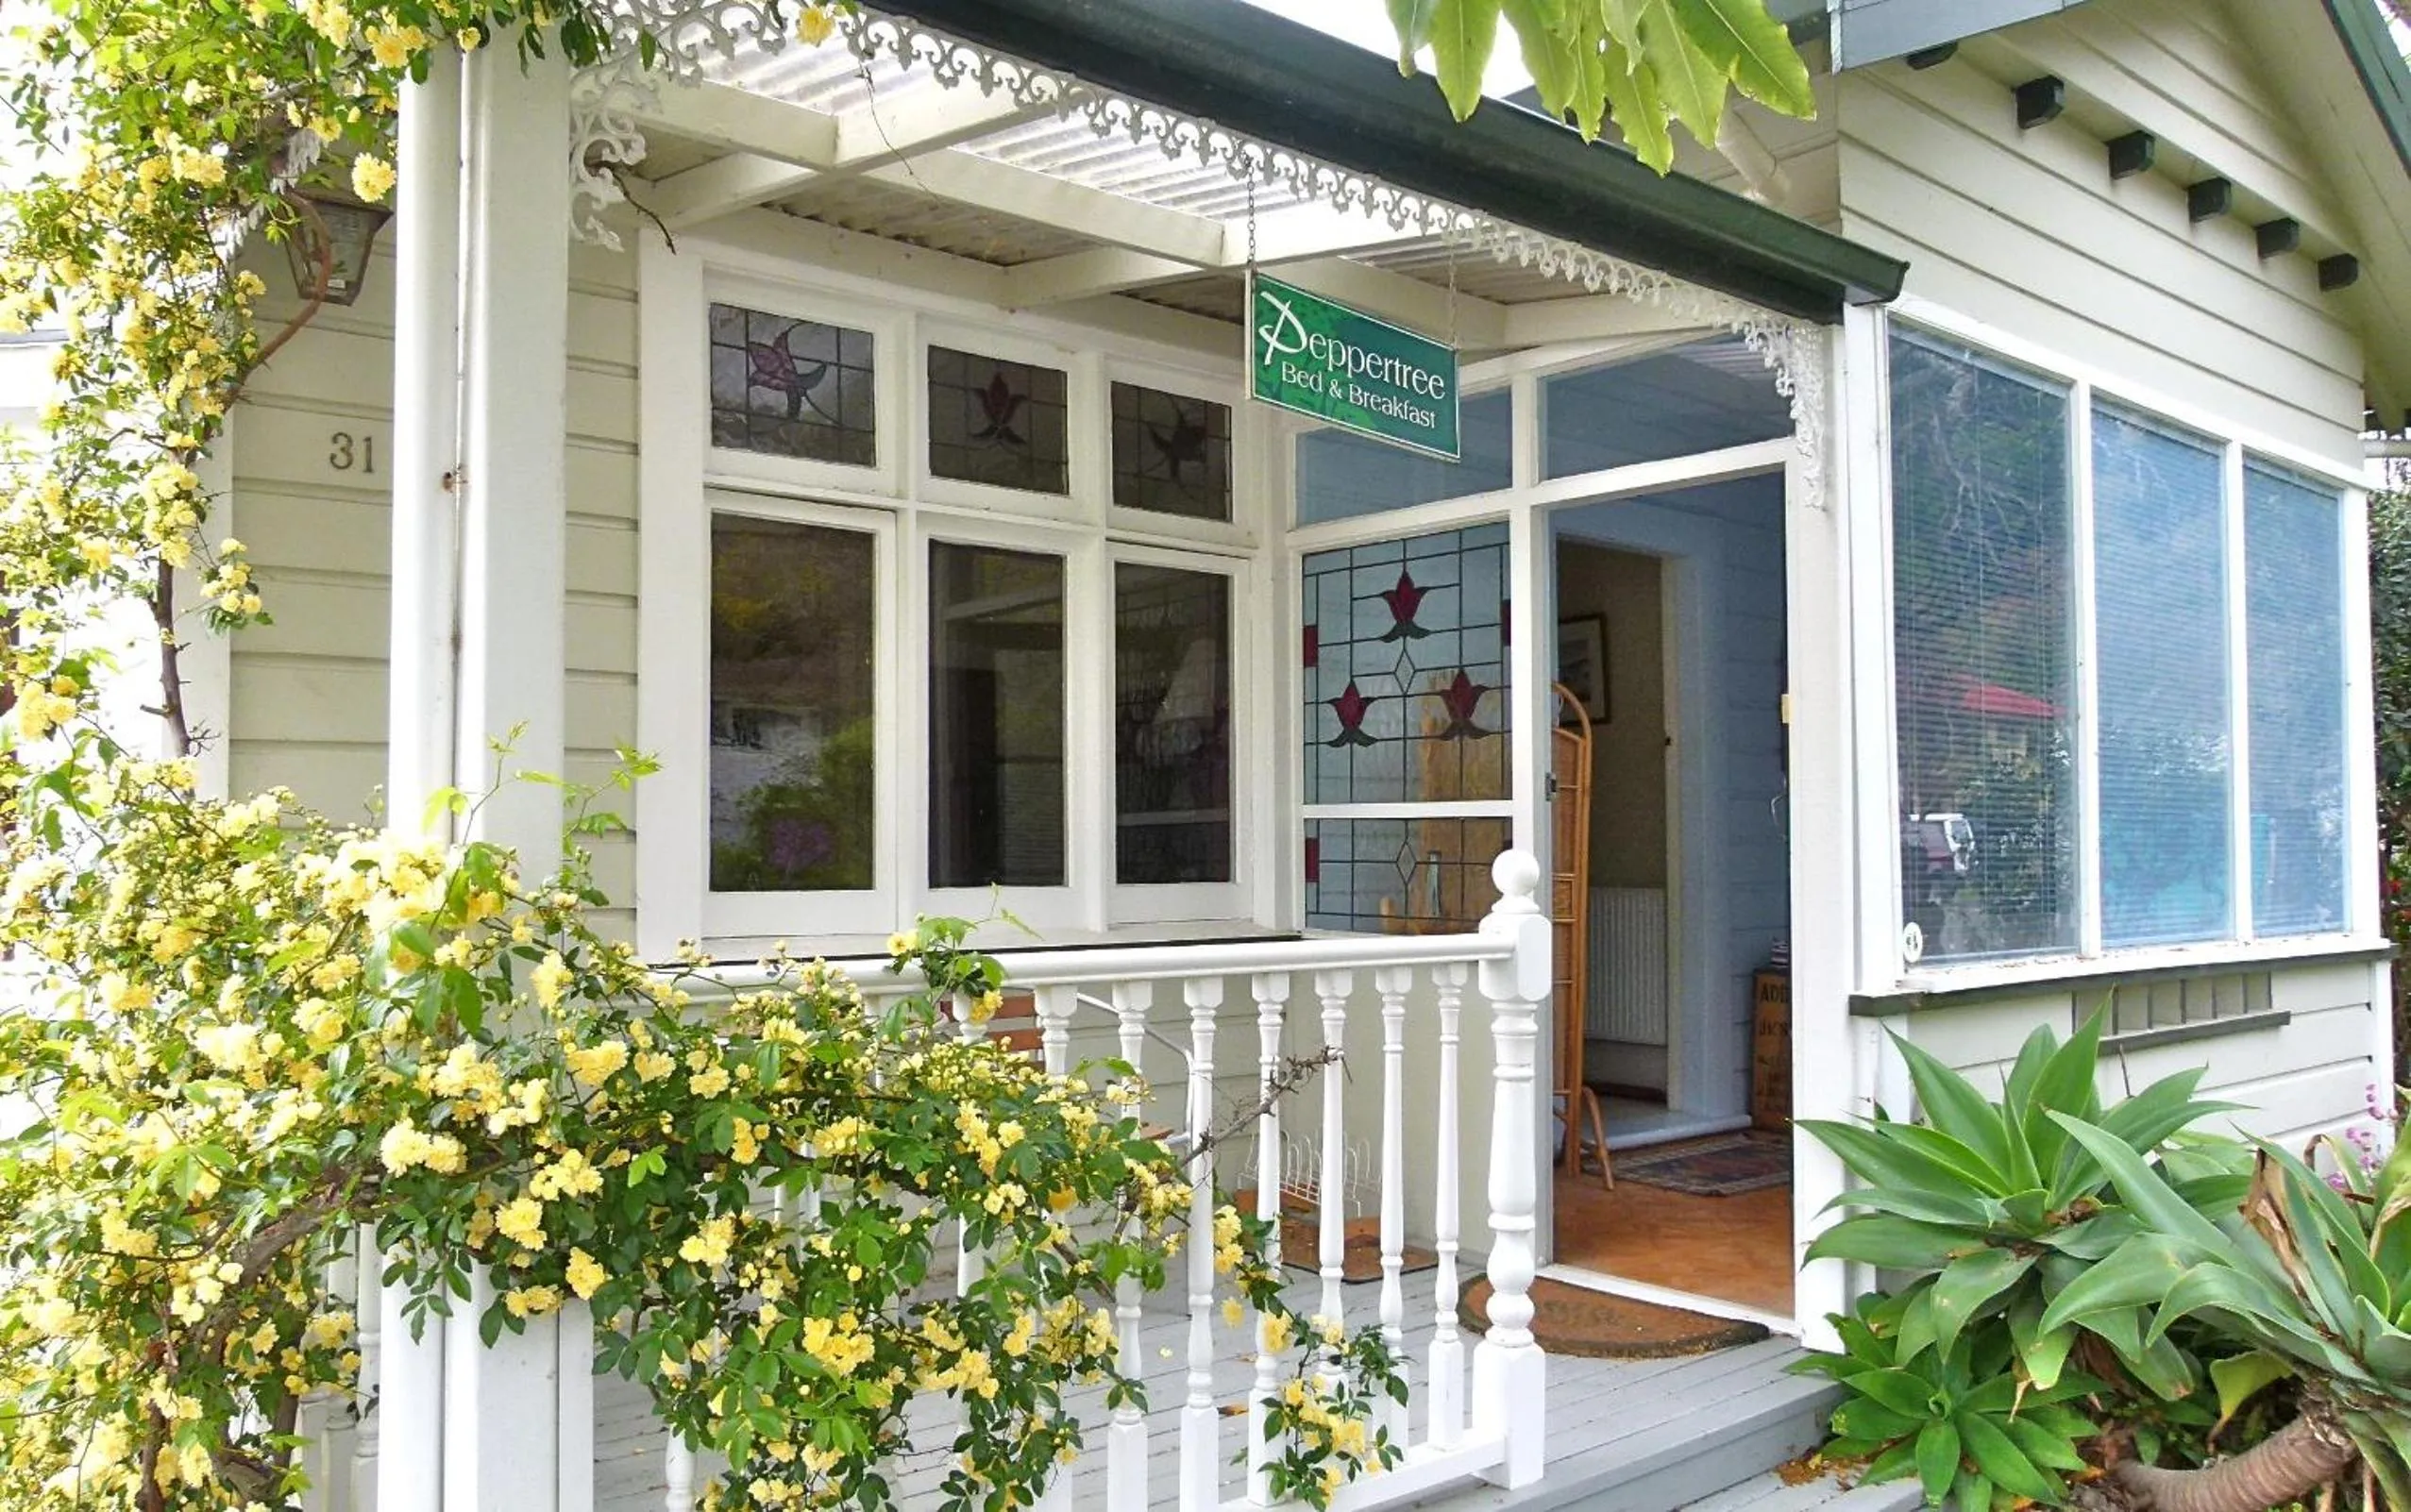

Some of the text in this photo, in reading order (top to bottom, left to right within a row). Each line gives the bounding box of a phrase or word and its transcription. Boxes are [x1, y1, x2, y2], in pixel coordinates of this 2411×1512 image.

[1258, 291, 1446, 399] Peppertree
[1282, 361, 1436, 428] Bed & Breakfast
[329, 431, 375, 473] 31
